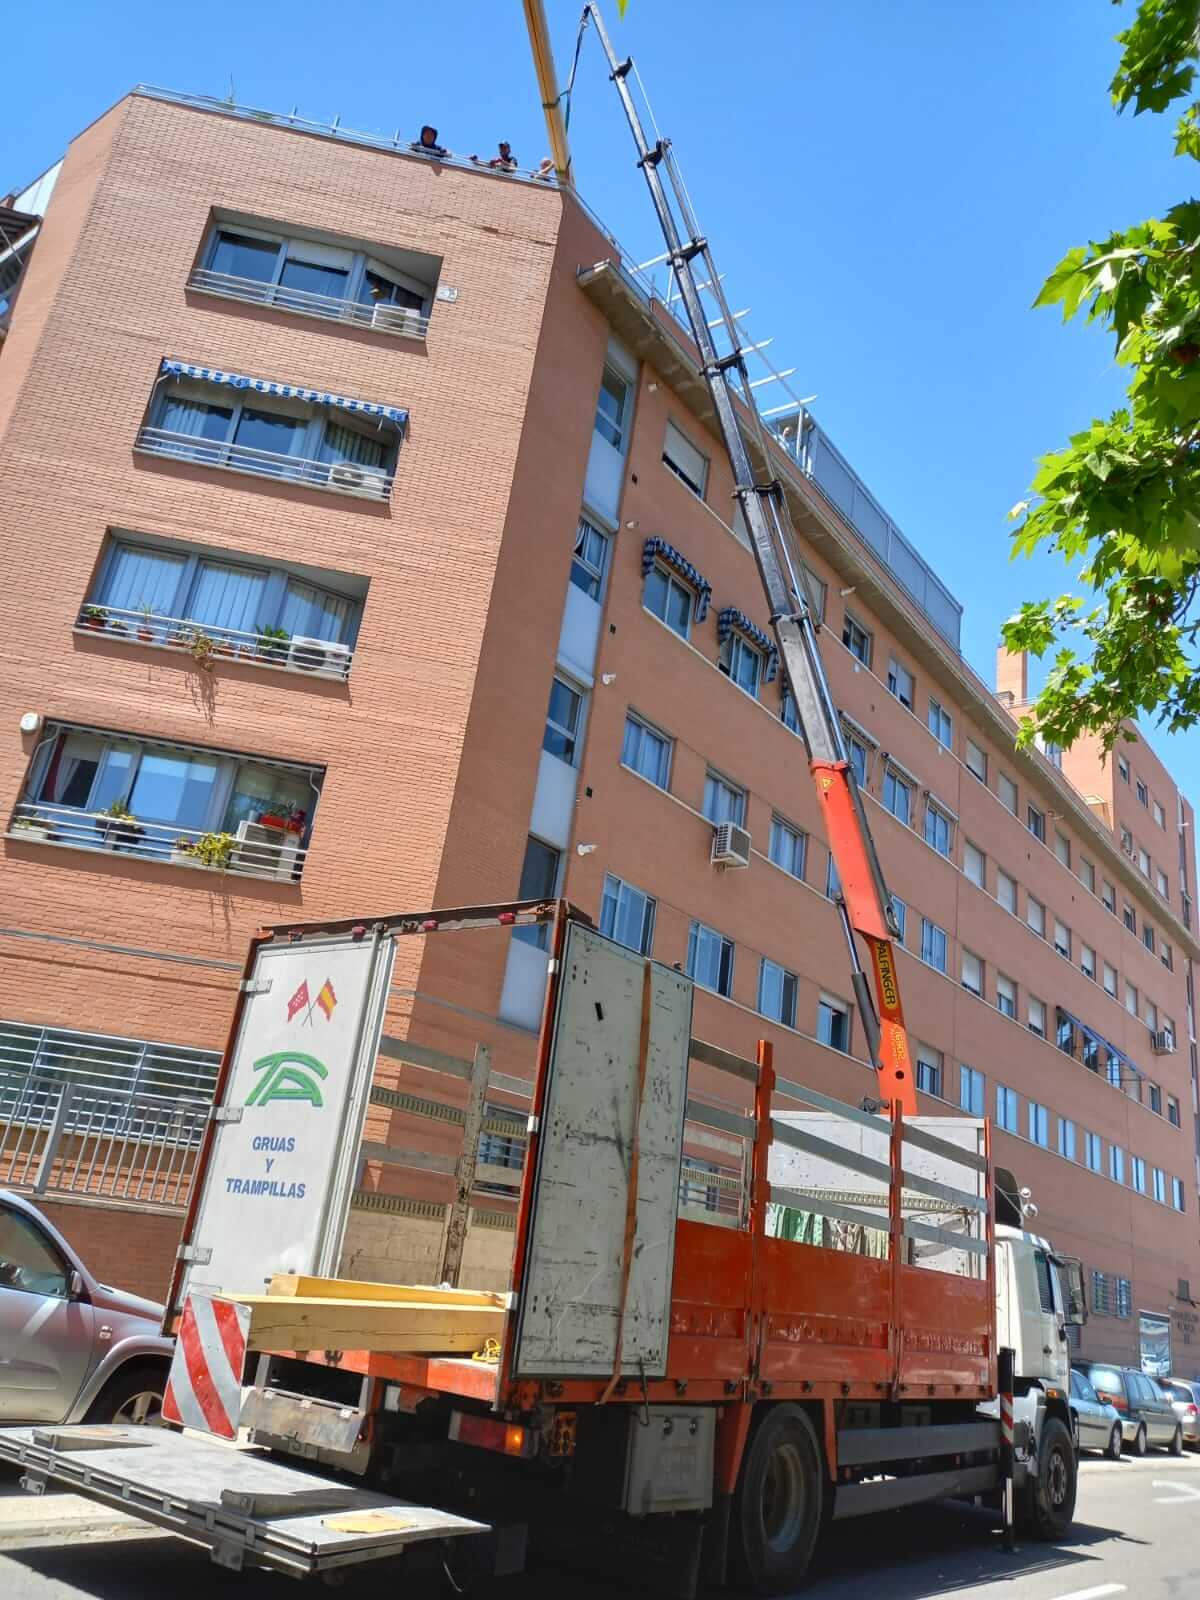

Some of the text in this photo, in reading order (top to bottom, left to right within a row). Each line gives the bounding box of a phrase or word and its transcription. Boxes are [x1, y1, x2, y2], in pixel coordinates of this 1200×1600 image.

[876, 941, 896, 1005] PALFINGER
[252, 1136, 295, 1152] GRUAS
[265, 1158, 275, 1173] Y
[226, 1178, 306, 1198] TRAMPILLAS
